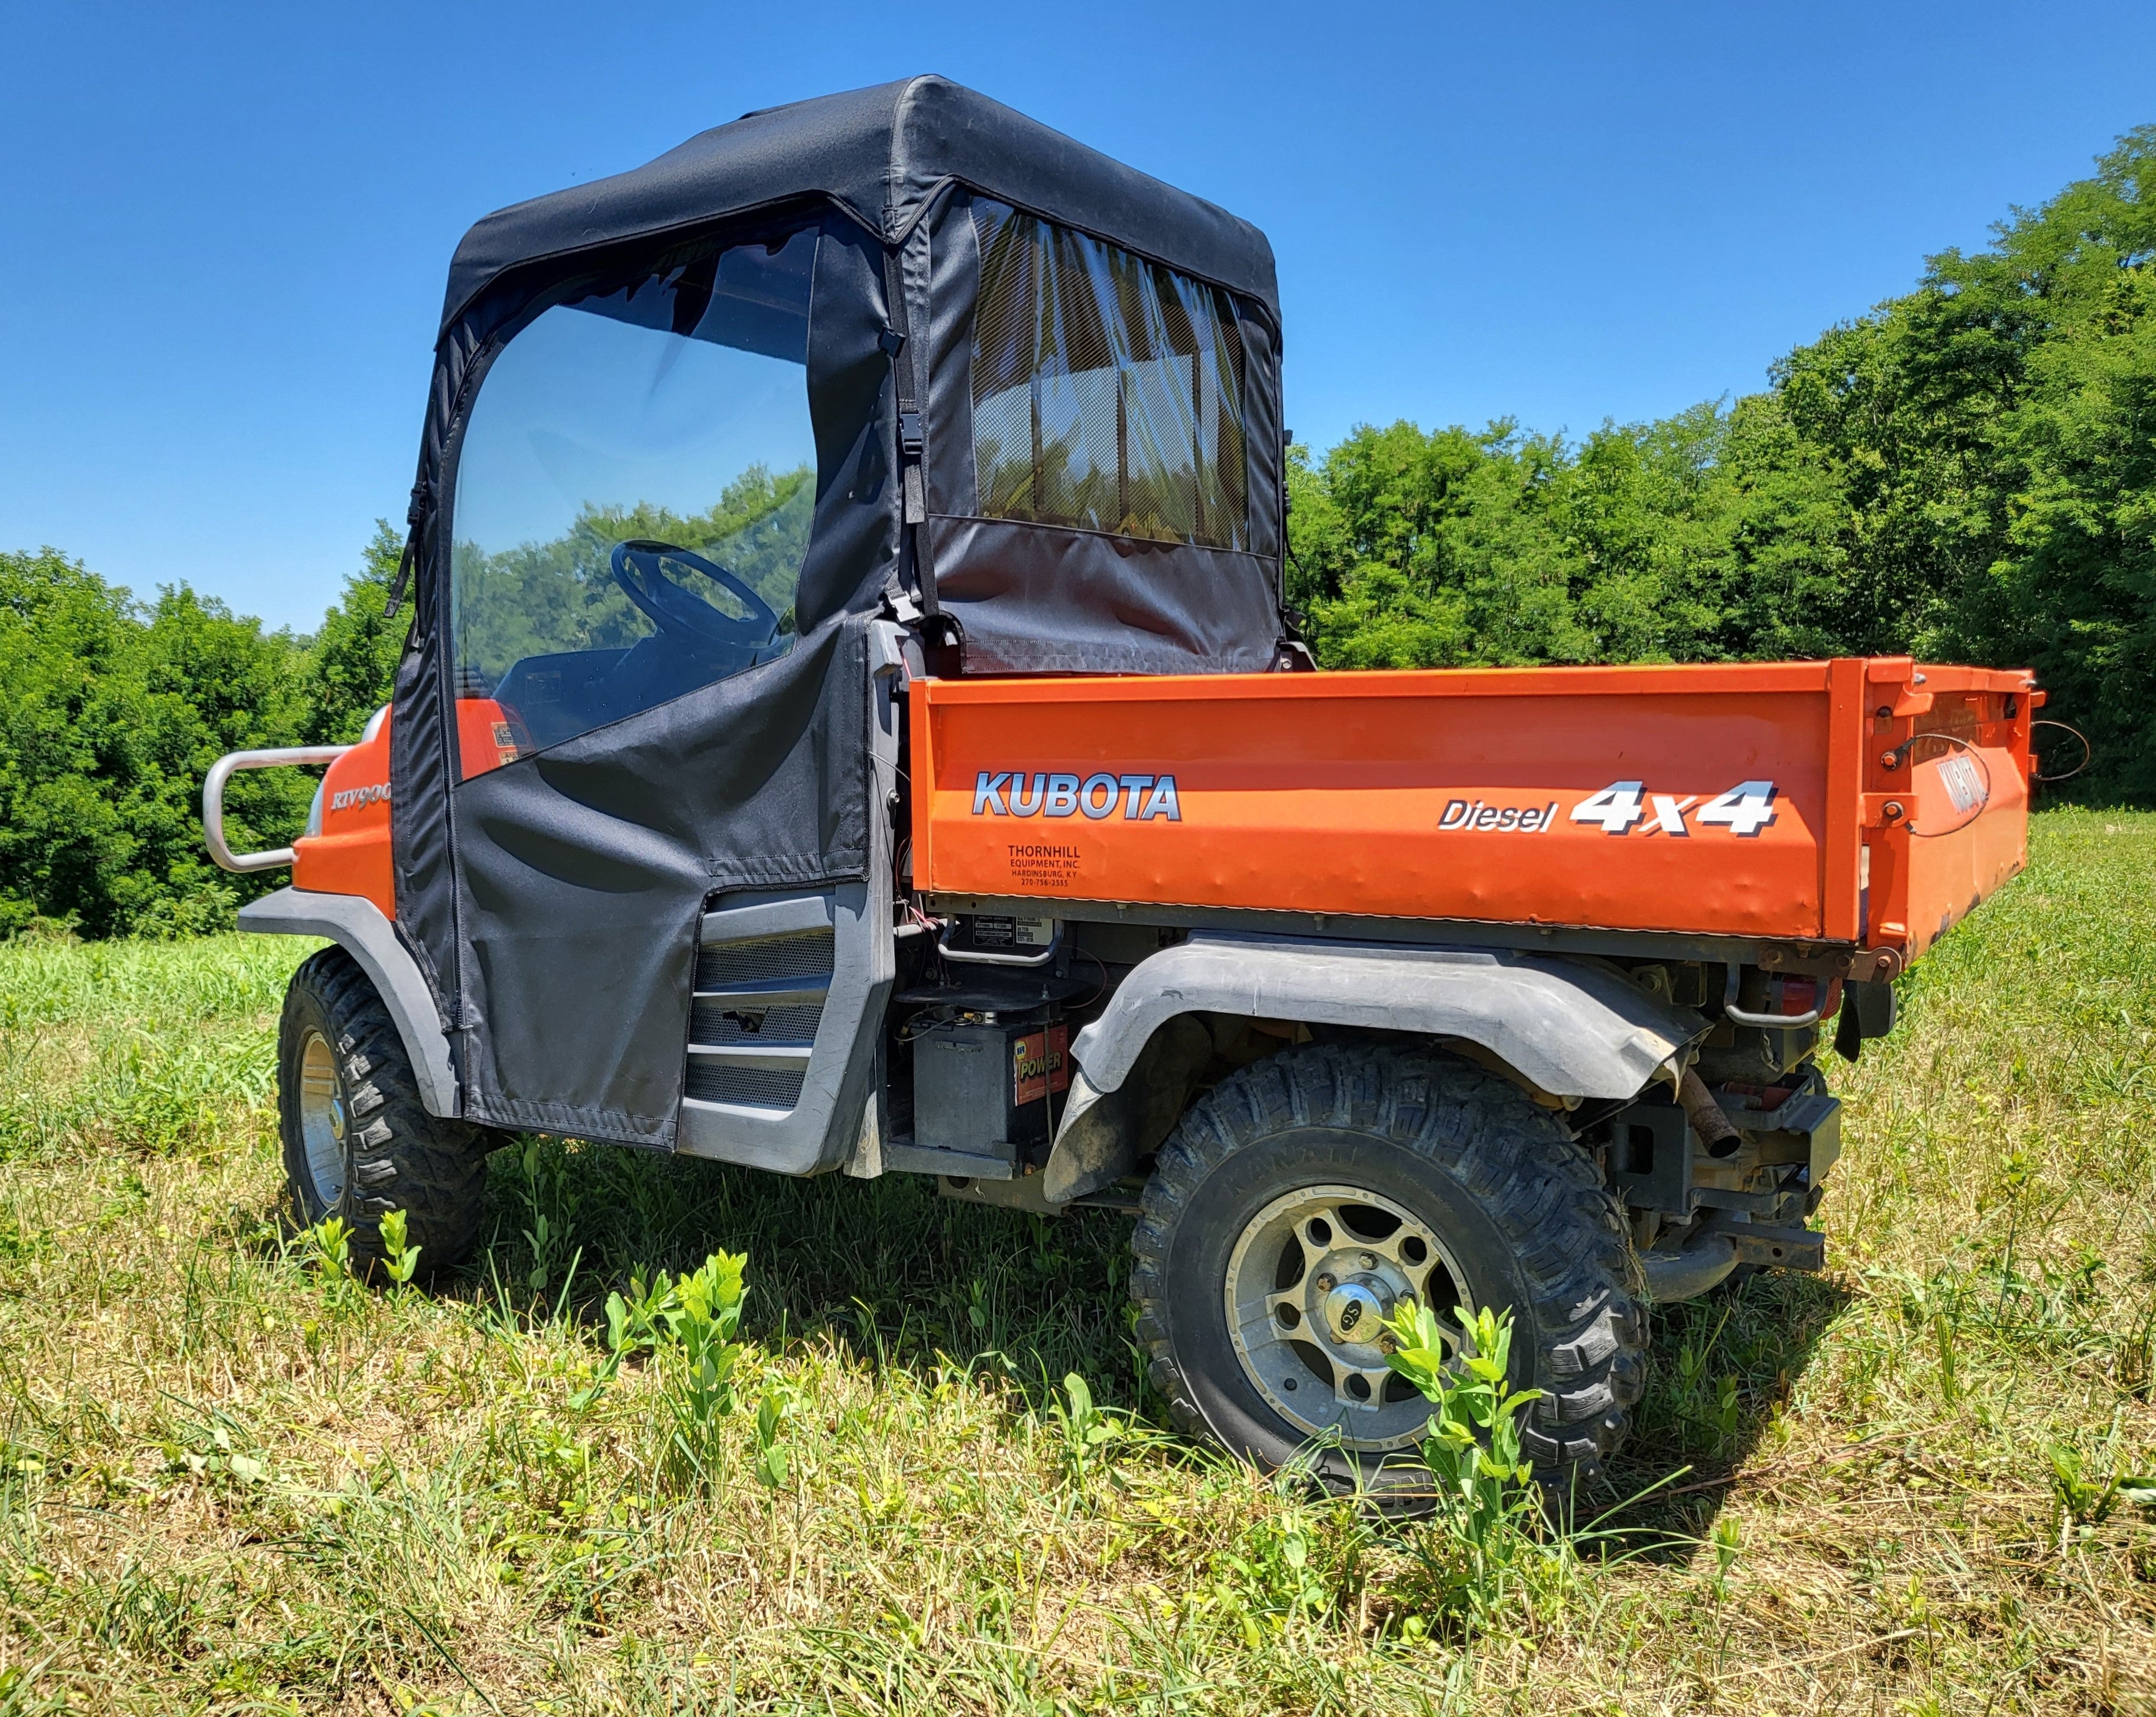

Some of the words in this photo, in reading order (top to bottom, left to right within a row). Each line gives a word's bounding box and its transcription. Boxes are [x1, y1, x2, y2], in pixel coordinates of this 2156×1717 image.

[330, 782, 391, 810] RTV900
[972, 772, 1181, 821] KUBOTA
[1438, 799, 1558, 833] Diesel
[1008, 846, 1080, 858] THORNHILL
[1011, 859, 1061, 869] EQUIPMENT,
[1063, 860, 1080, 869] INC.
[1012, 870, 1064, 879] HARDINSBURG,
[1020, 1051, 1061, 1080] POWER
[1342, 1305, 1359, 1326] SG
